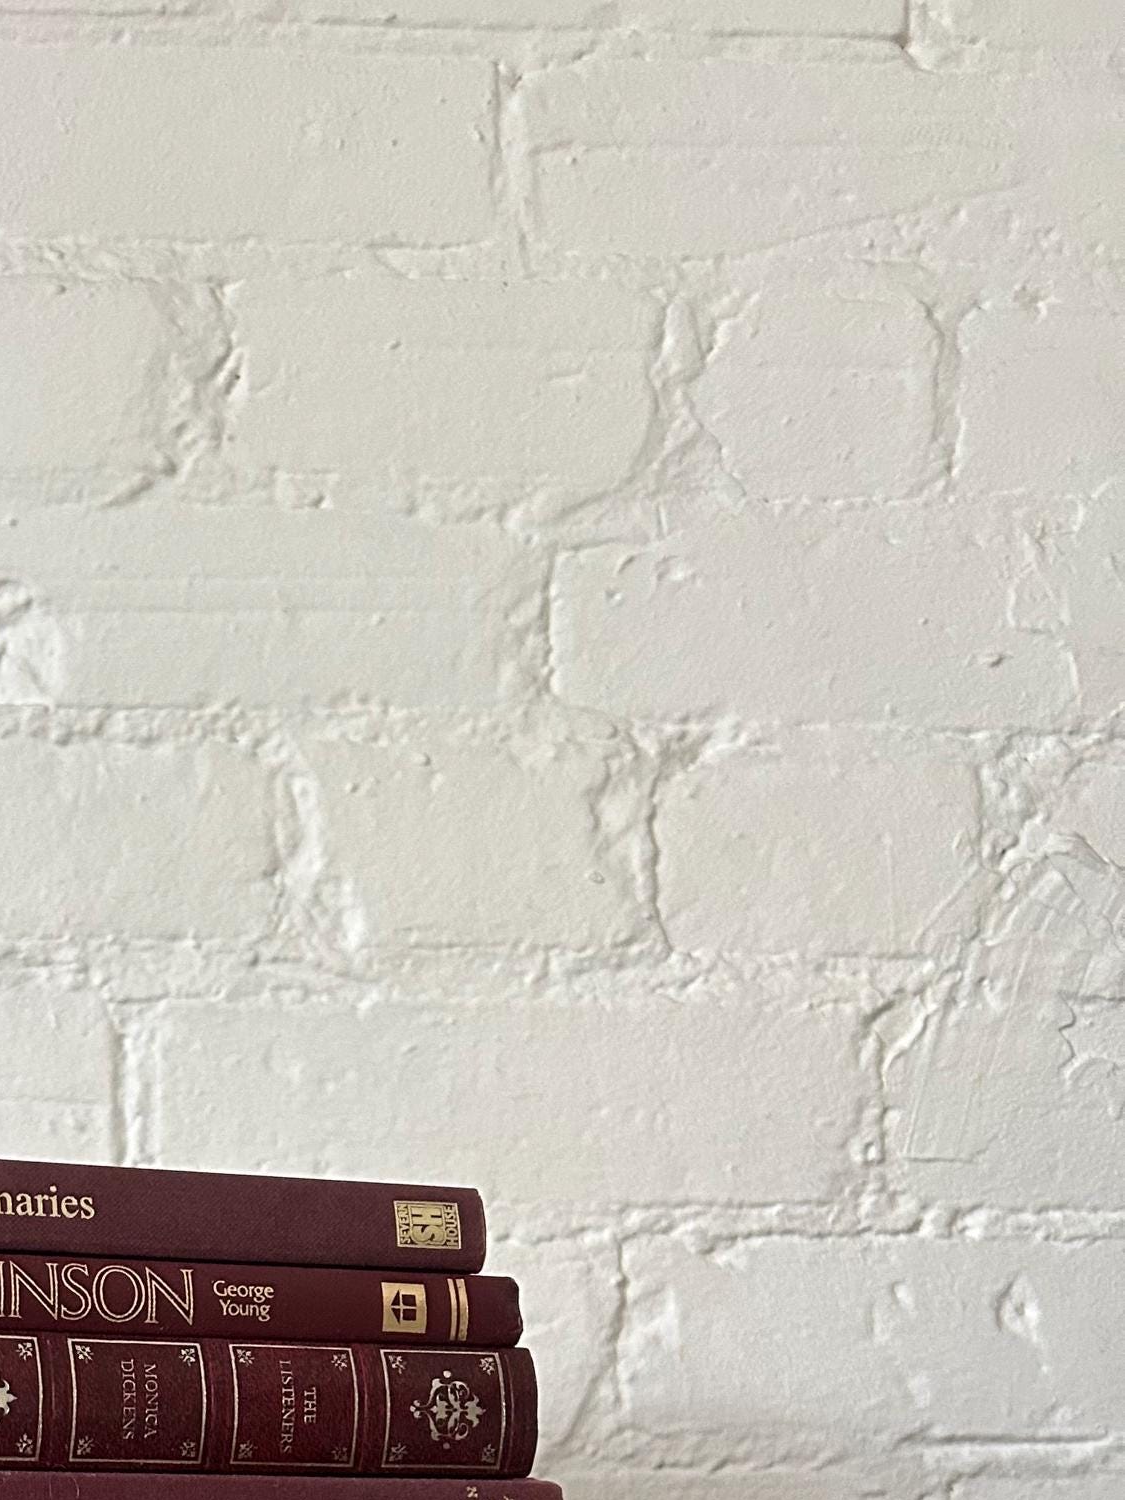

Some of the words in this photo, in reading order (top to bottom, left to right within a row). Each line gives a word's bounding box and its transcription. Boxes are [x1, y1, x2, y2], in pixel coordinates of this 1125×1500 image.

[444, 1204, 459, 1247] HOUSE
[213, 1281, 275, 1304] George
[218, 1302, 271, 1321] Young
[120, 1358, 136, 1440] DICKENS
[143, 1363, 159, 1439] MONICA
[279, 1359, 295, 1454] LISTENERS
[303, 1387, 316, 1424] THE
